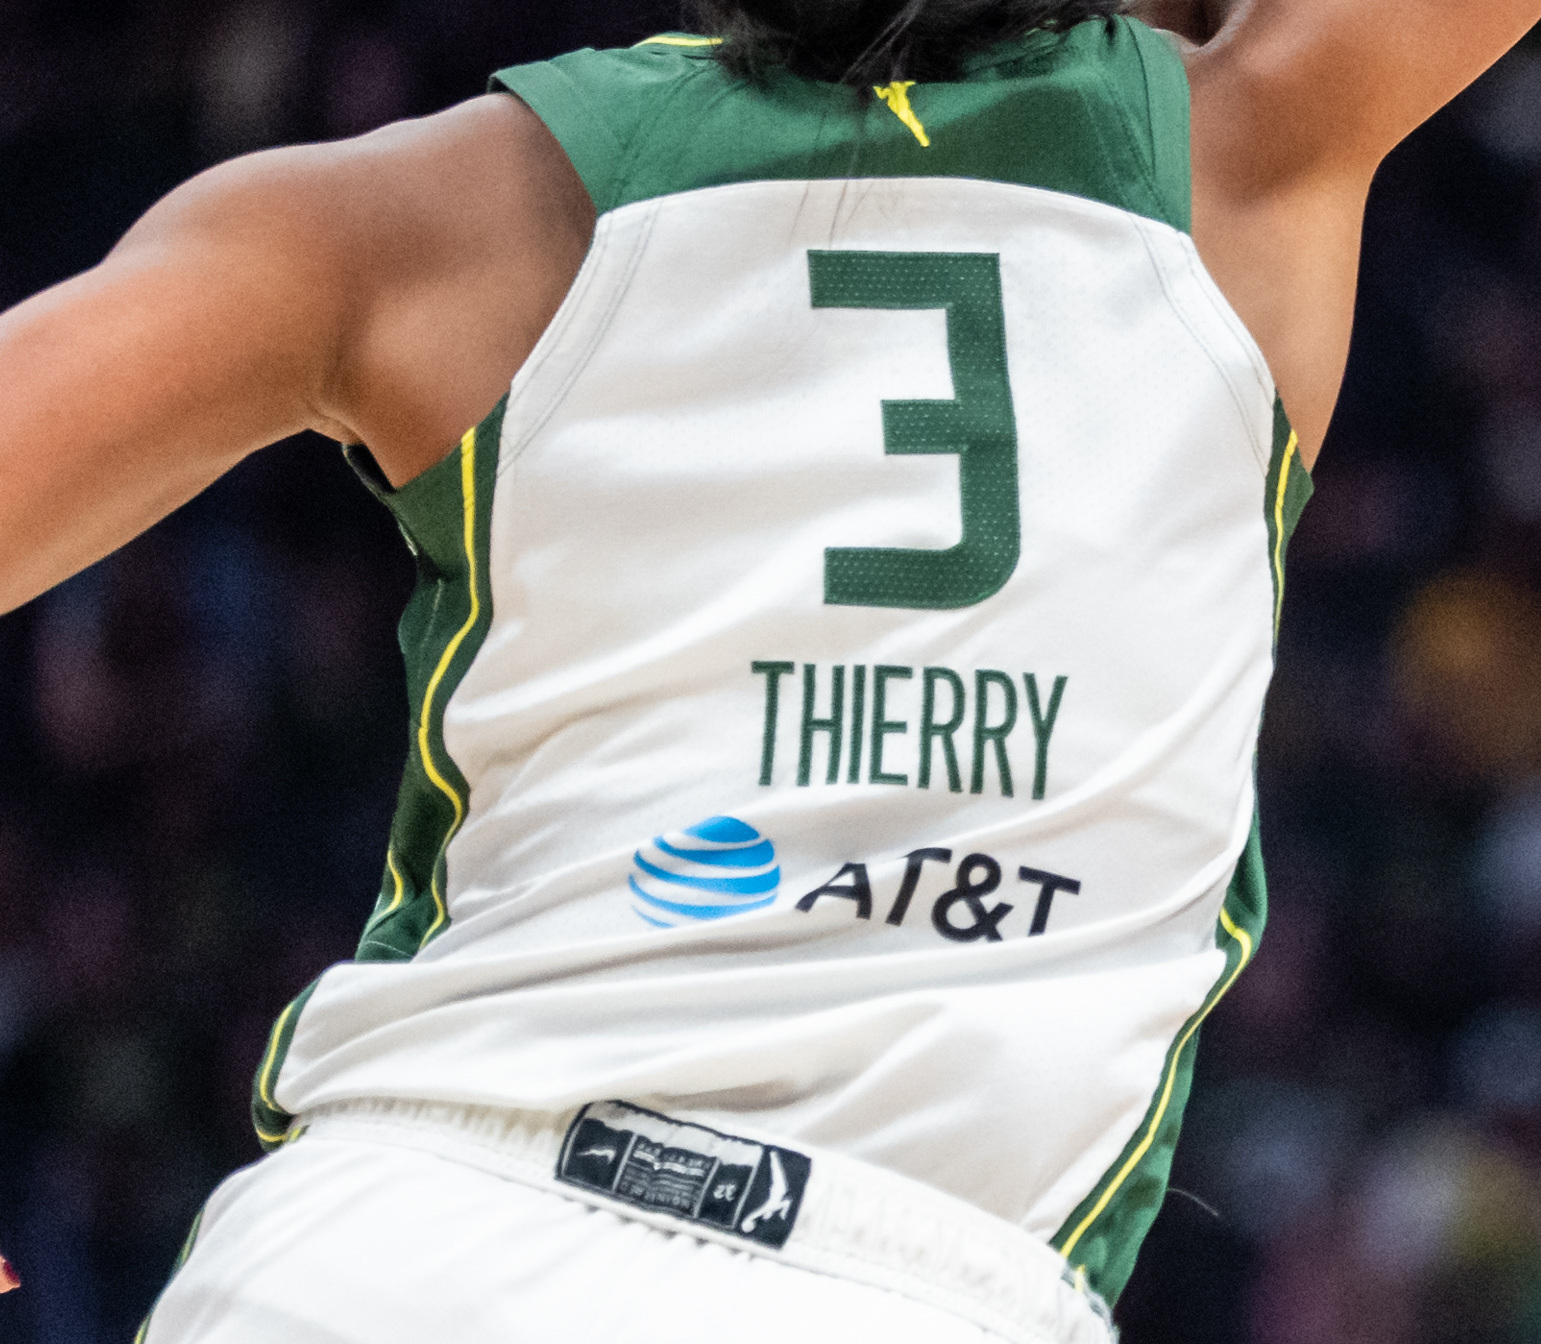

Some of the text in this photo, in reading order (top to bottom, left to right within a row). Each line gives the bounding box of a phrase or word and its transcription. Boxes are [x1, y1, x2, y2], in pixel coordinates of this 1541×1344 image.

[807, 249, 1021, 611] 3
[751, 659, 1069, 801] THIERRY
[795, 846, 1082, 944] AT&T
